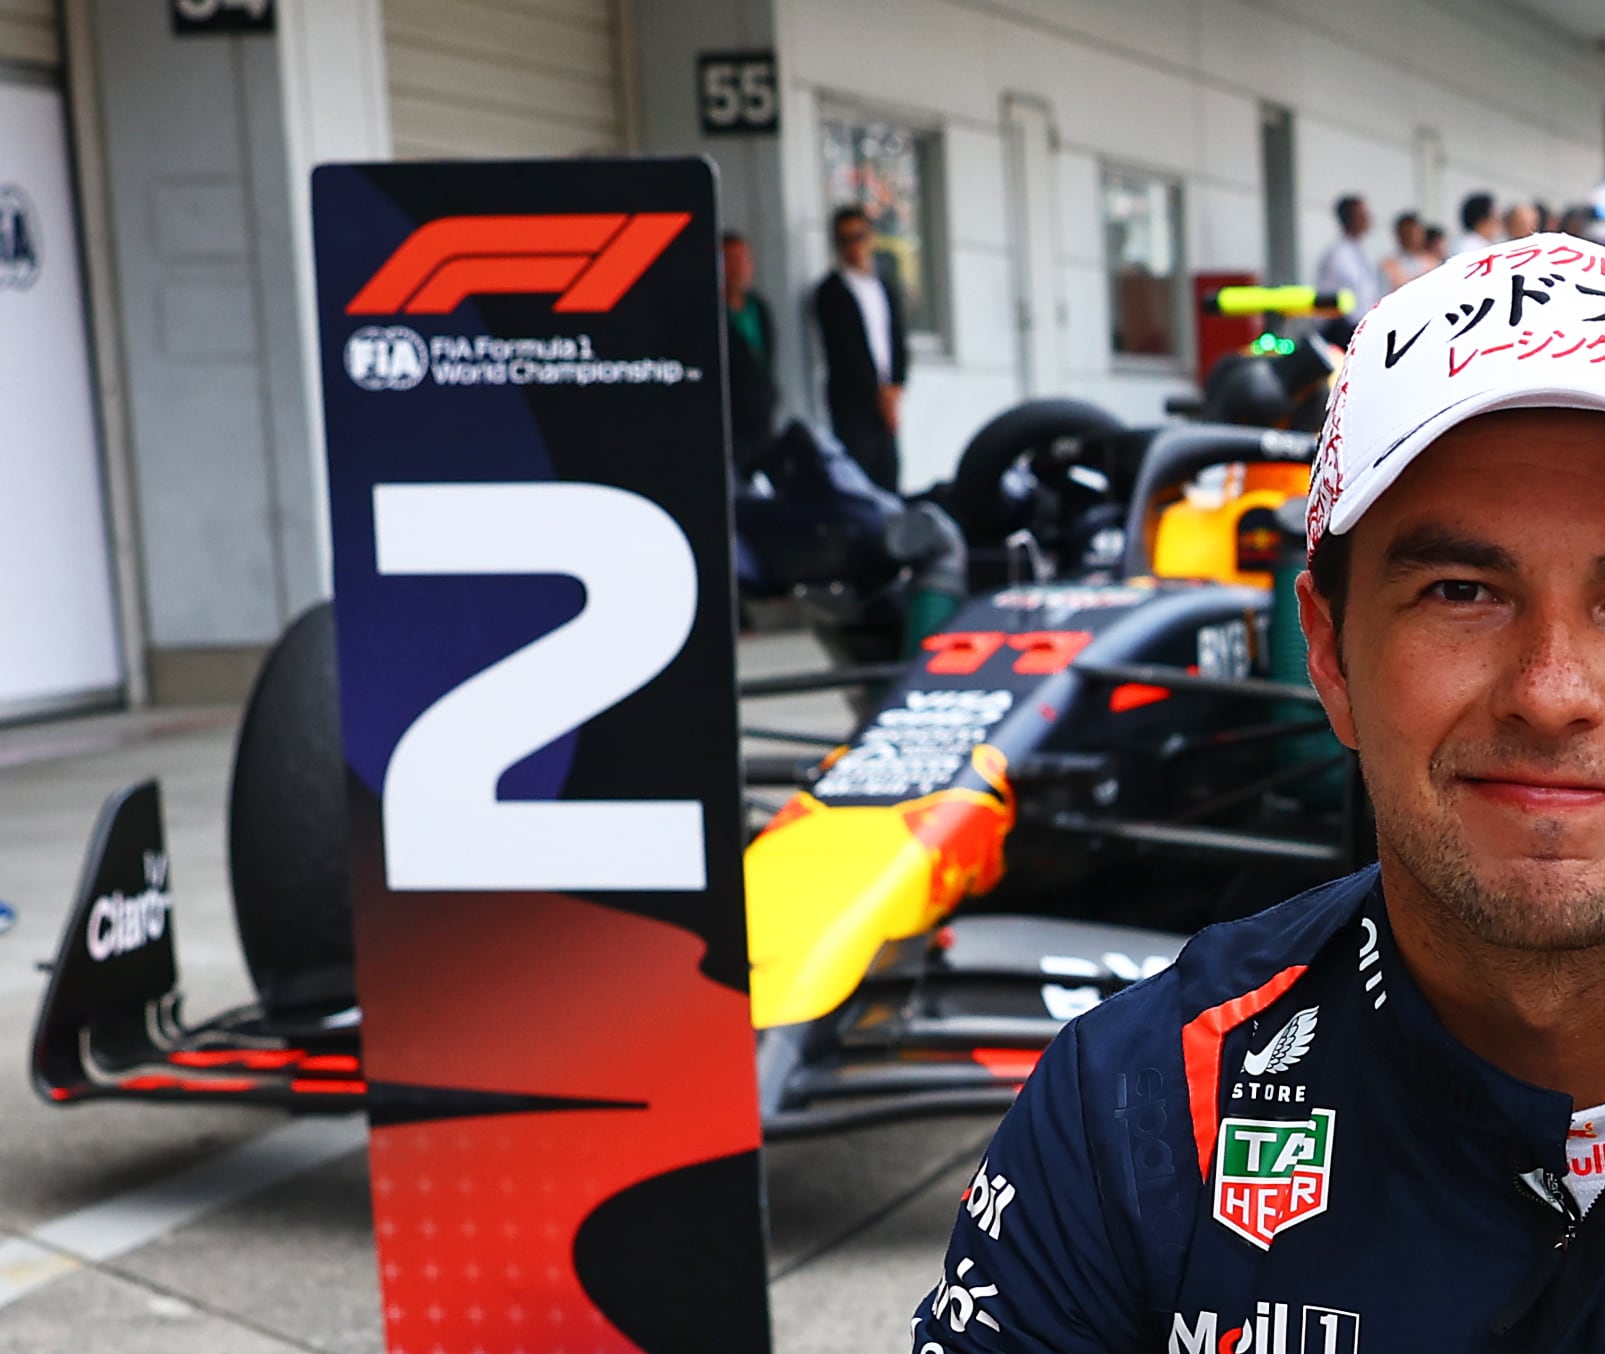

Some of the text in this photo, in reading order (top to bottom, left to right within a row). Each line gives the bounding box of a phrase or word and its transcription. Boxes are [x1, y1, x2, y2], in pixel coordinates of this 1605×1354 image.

[705, 64, 773, 122] 55
[344, 212, 693, 314] F1
[349, 338, 423, 380] FIA
[430, 334, 593, 360] FIA Formula 1
[430, 360, 684, 386] World Championship
[372, 482, 708, 891] 2
[1231, 1081, 1308, 1103] STORE
[960, 1172, 1016, 1240] bil
